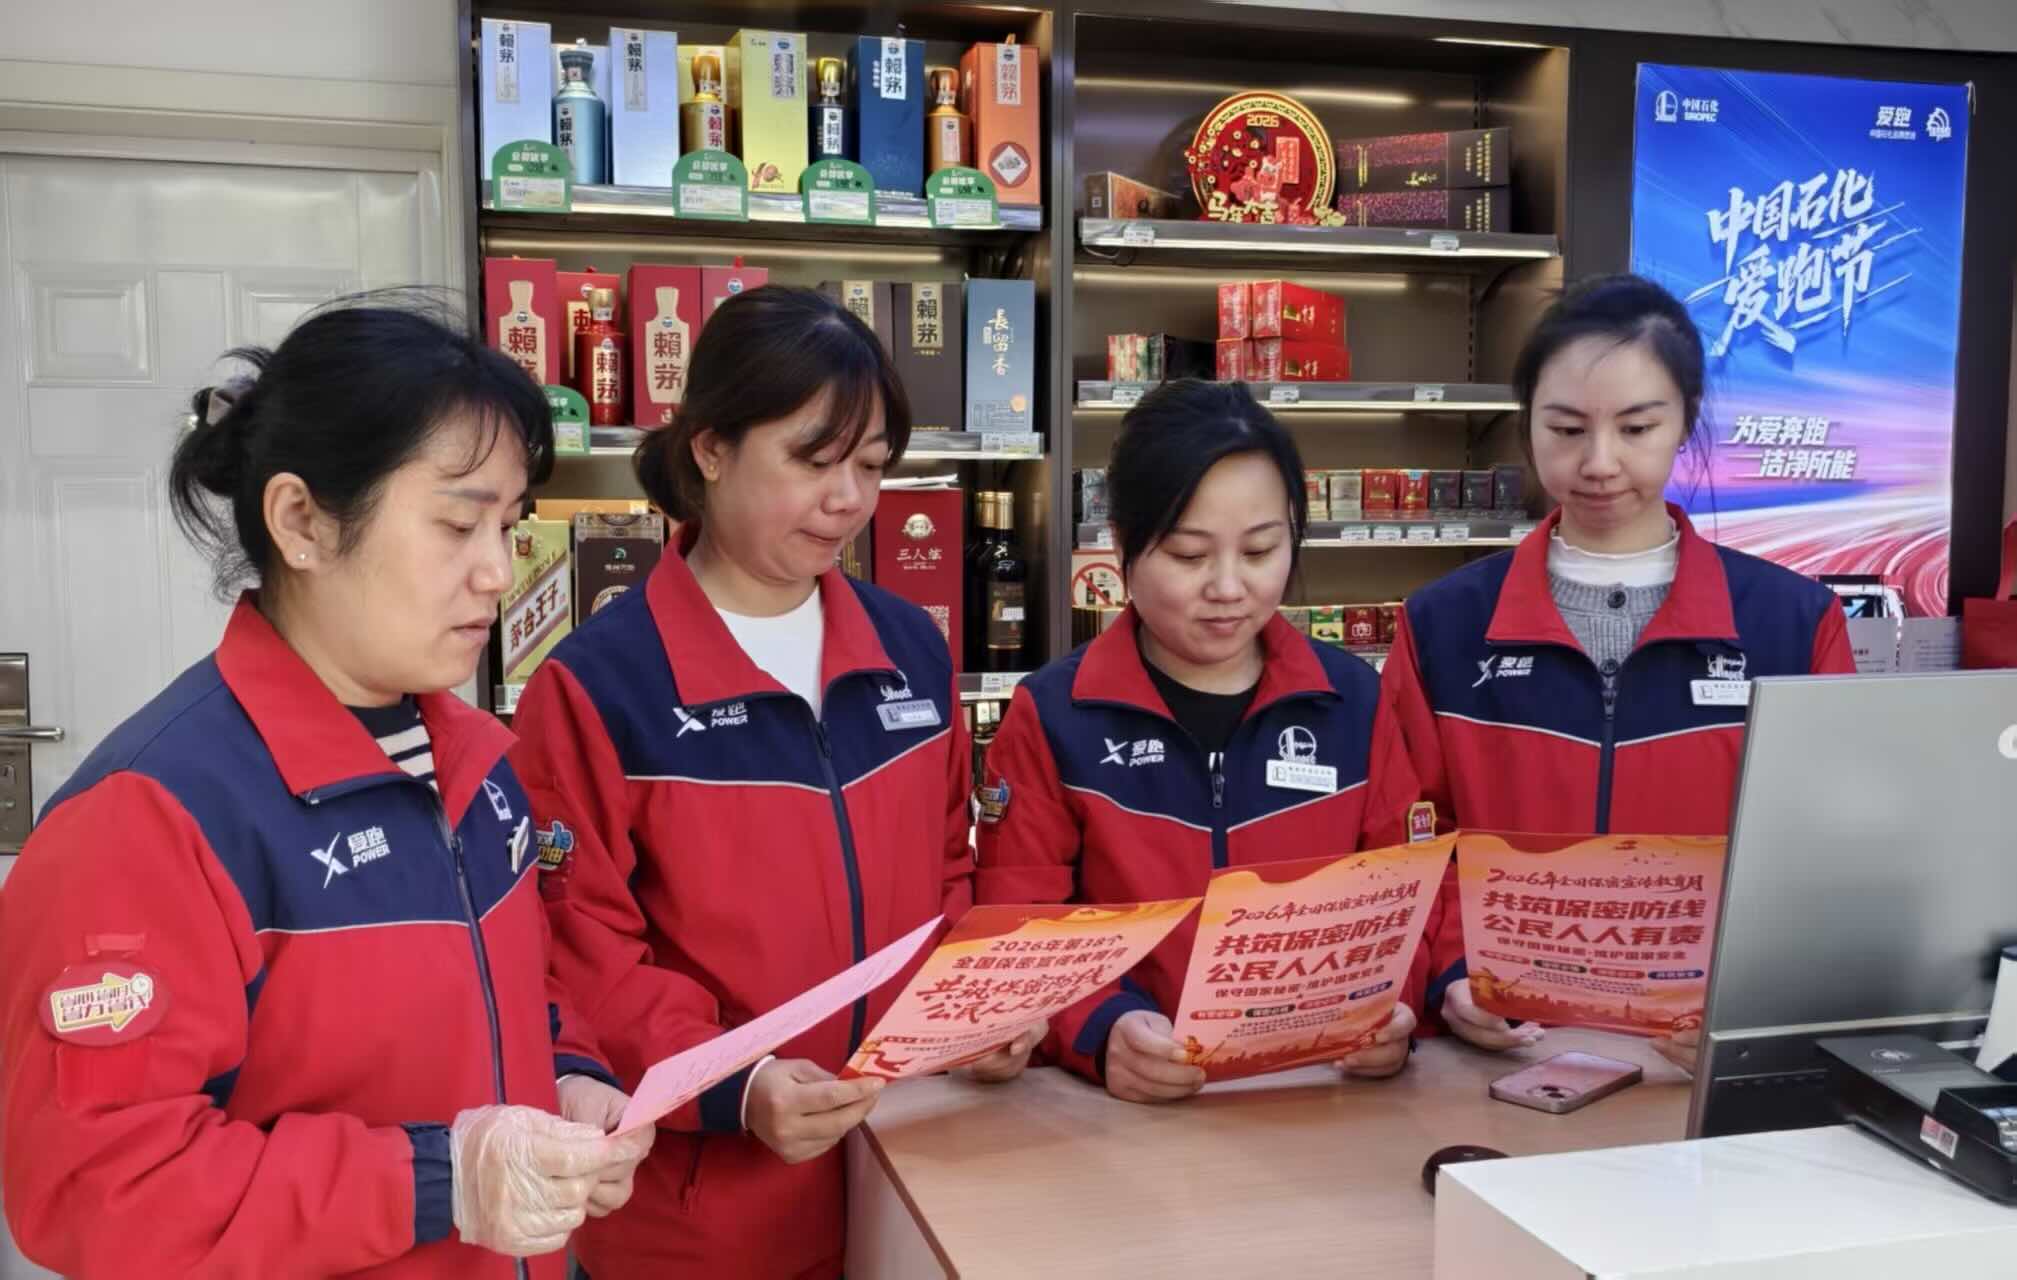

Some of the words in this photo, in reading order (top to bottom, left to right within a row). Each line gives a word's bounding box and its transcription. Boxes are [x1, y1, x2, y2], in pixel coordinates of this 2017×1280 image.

[1682, 98, 1720, 113] 中国石化
[1876, 106, 1912, 128] 爱跑
[1705, 168, 1875, 275] 中国石化
[1711, 220, 1888, 357] 爱跑节
[917, 298, 939, 344] 賴茅
[596, 351, 619, 400] 賴茅
[654, 331, 682, 391] 賴茅
[1734, 415, 1831, 445] 为爱奔跑
[1760, 449, 1857, 480] 洁净所能
[711, 714, 749, 728] POWER
[1129, 753, 1165, 767] POWER
[1131, 738, 1166, 757] 爱跑
[352, 844, 391, 868] POWER
[1482, 890, 1706, 920] 共筑保密防线
[1213, 905, 1416, 957] 共筑保密防线
[1482, 913, 1705, 946] 公民人人有责
[1205, 934, 1407, 985] 公民人人有责
